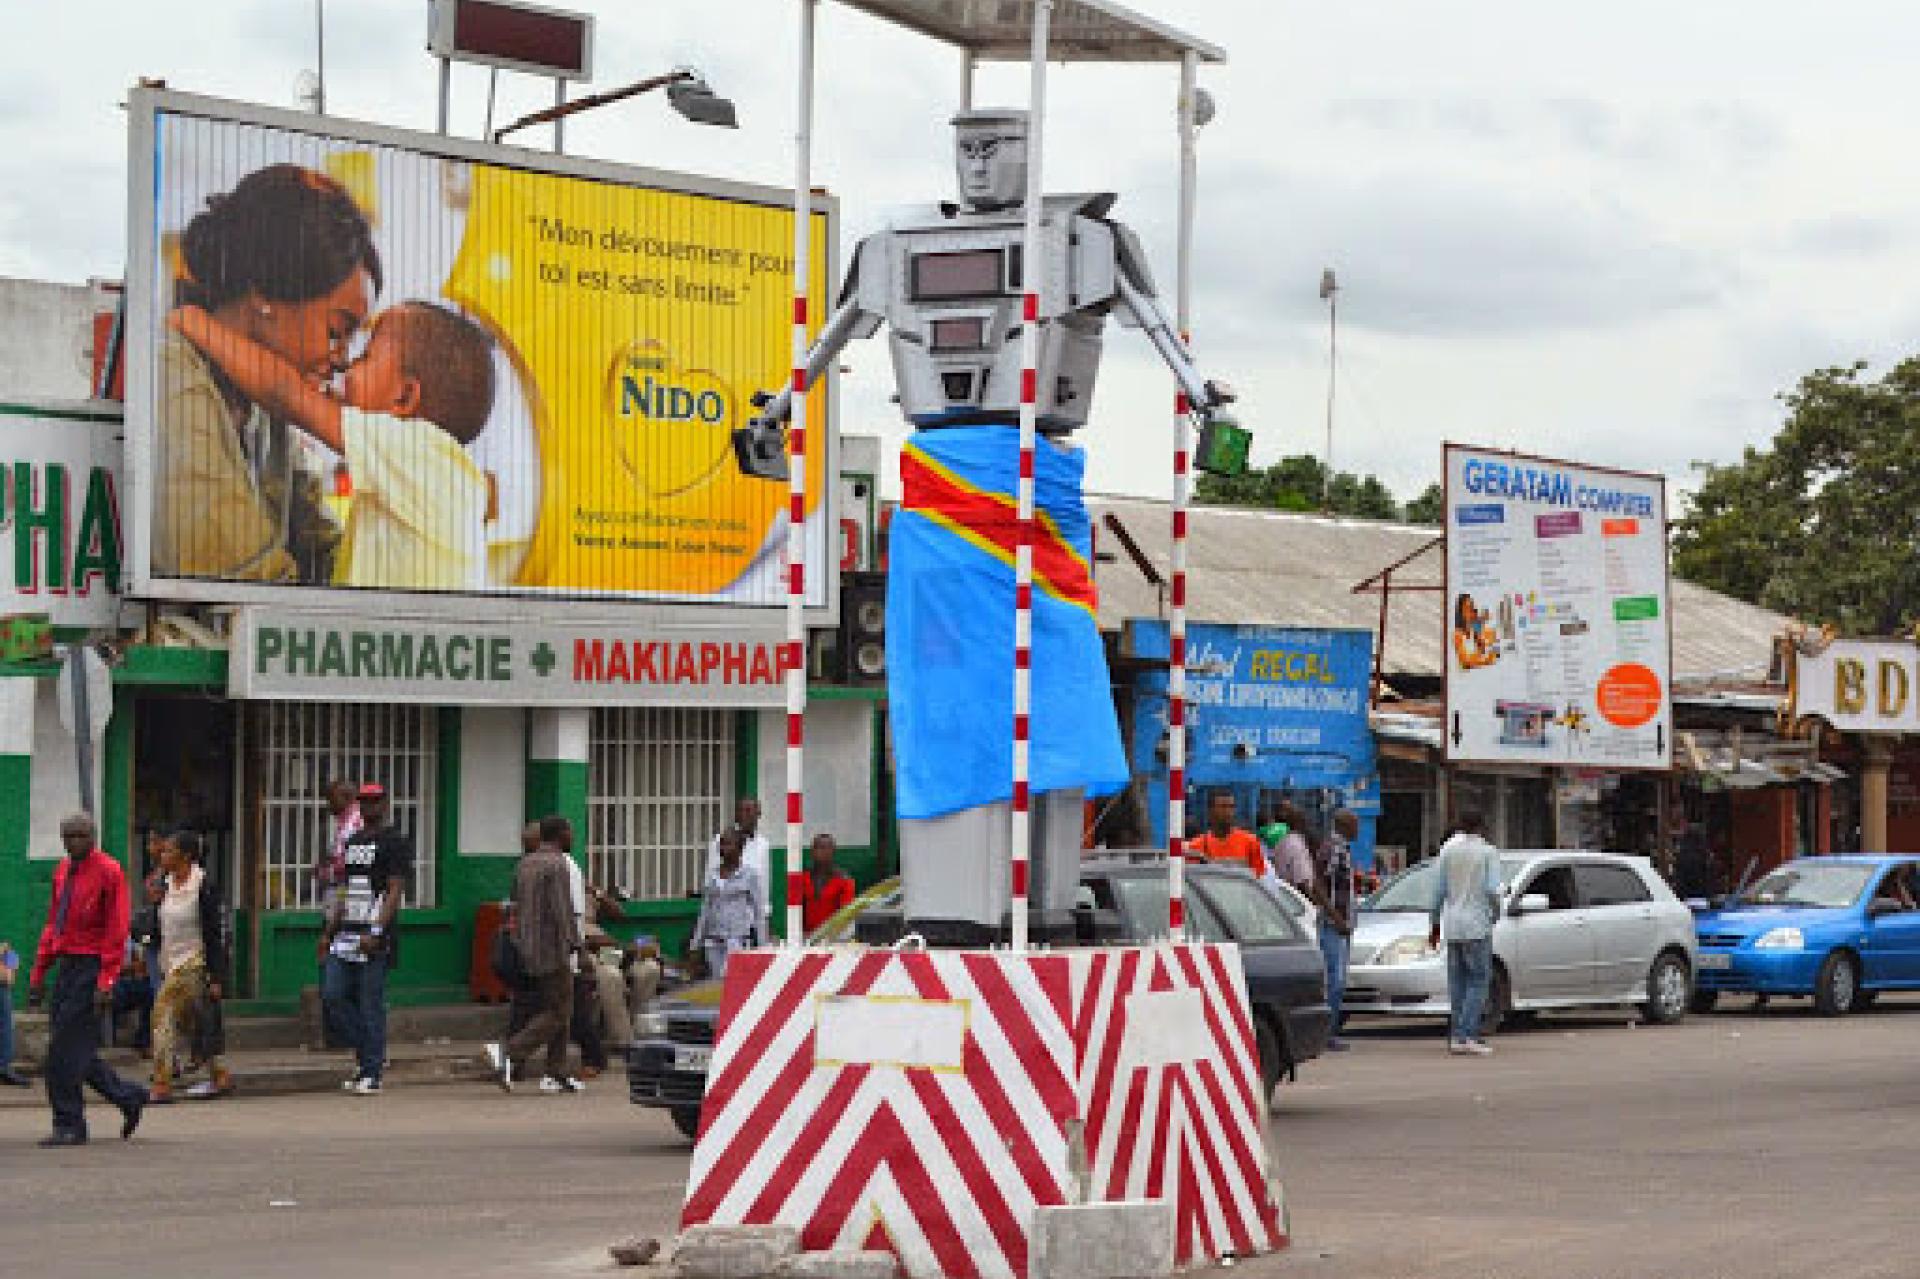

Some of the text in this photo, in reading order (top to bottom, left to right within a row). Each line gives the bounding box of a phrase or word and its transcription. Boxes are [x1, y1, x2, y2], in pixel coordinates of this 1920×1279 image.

[539, 262, 570, 285] toi
[577, 270, 608, 290] est
[618, 275, 664, 298] sans
[1465, 458, 1572, 508] GERATAM
[255, 627, 511, 681] PHARMACIE
[1251, 650, 1335, 683] REGAL
